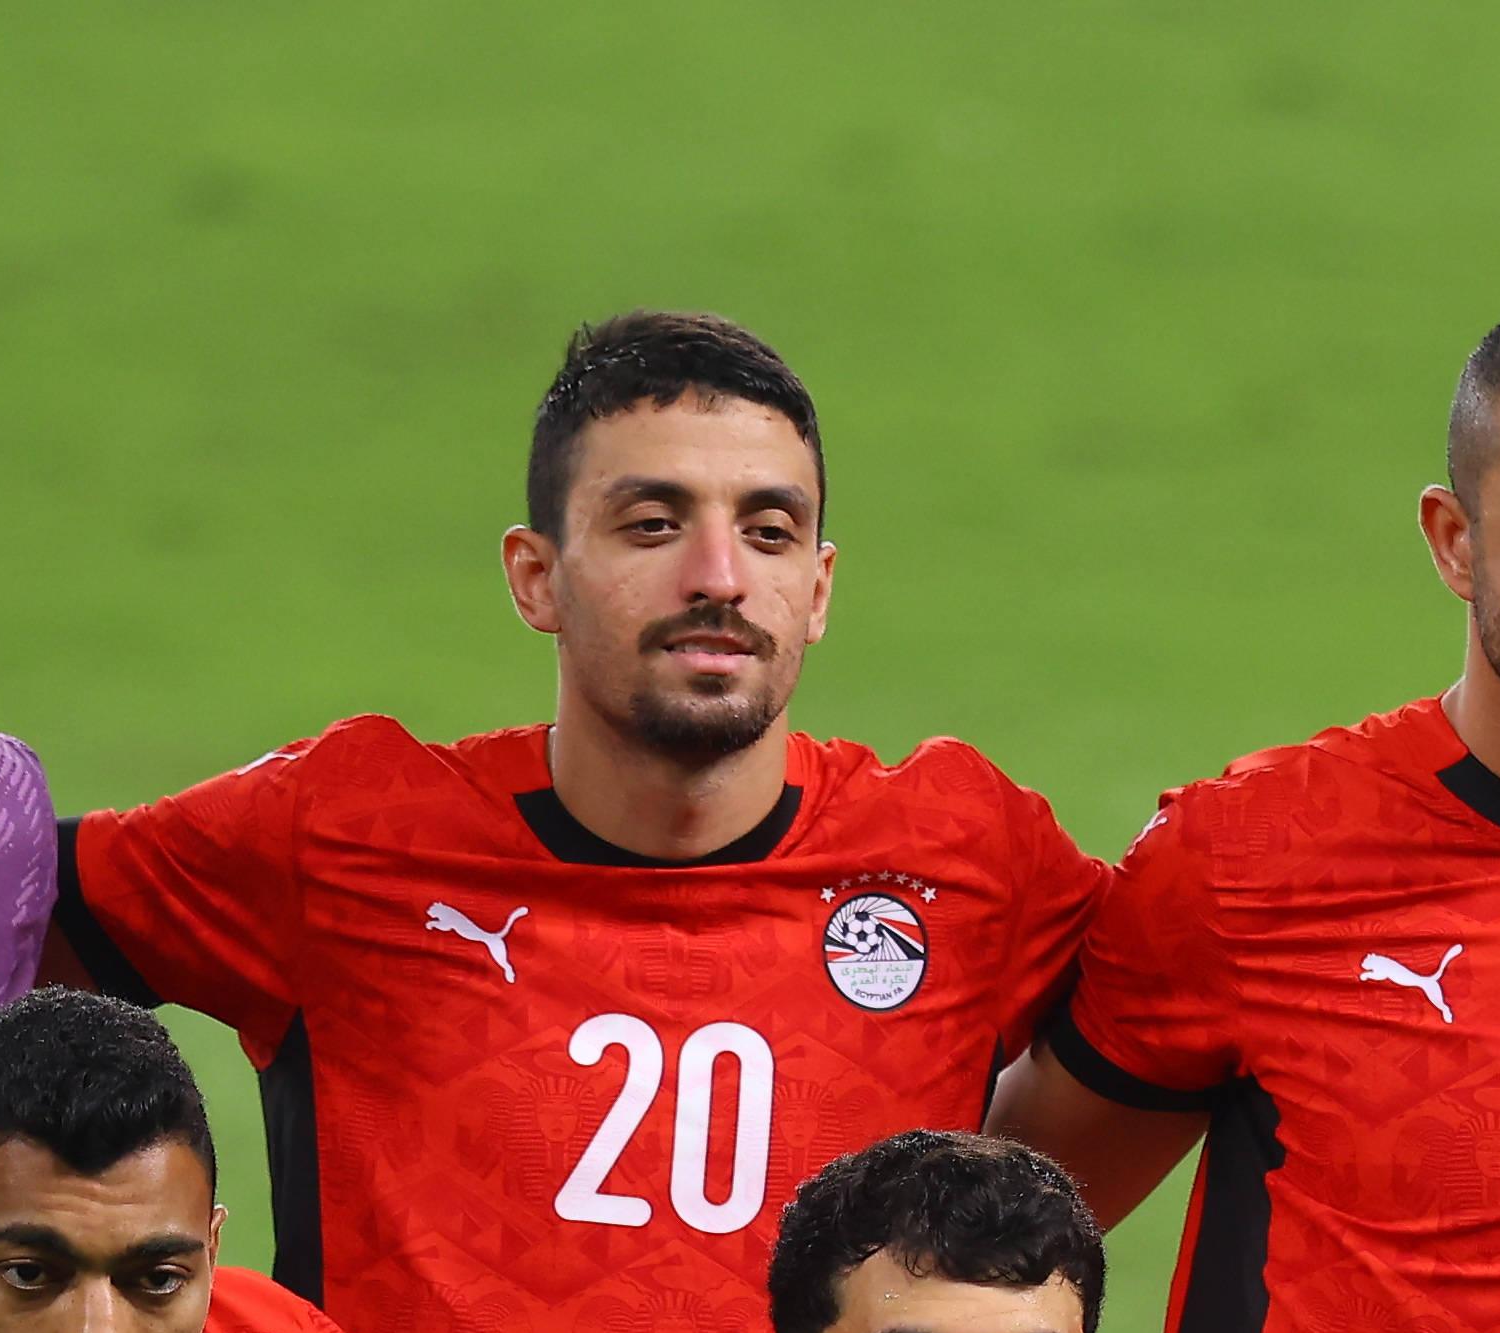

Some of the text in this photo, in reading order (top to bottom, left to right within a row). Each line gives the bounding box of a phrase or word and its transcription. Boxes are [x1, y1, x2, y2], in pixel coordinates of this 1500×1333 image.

[855, 986, 904, 1000] EGYPTIAN FA
[553, 1012, 775, 1234] 20
